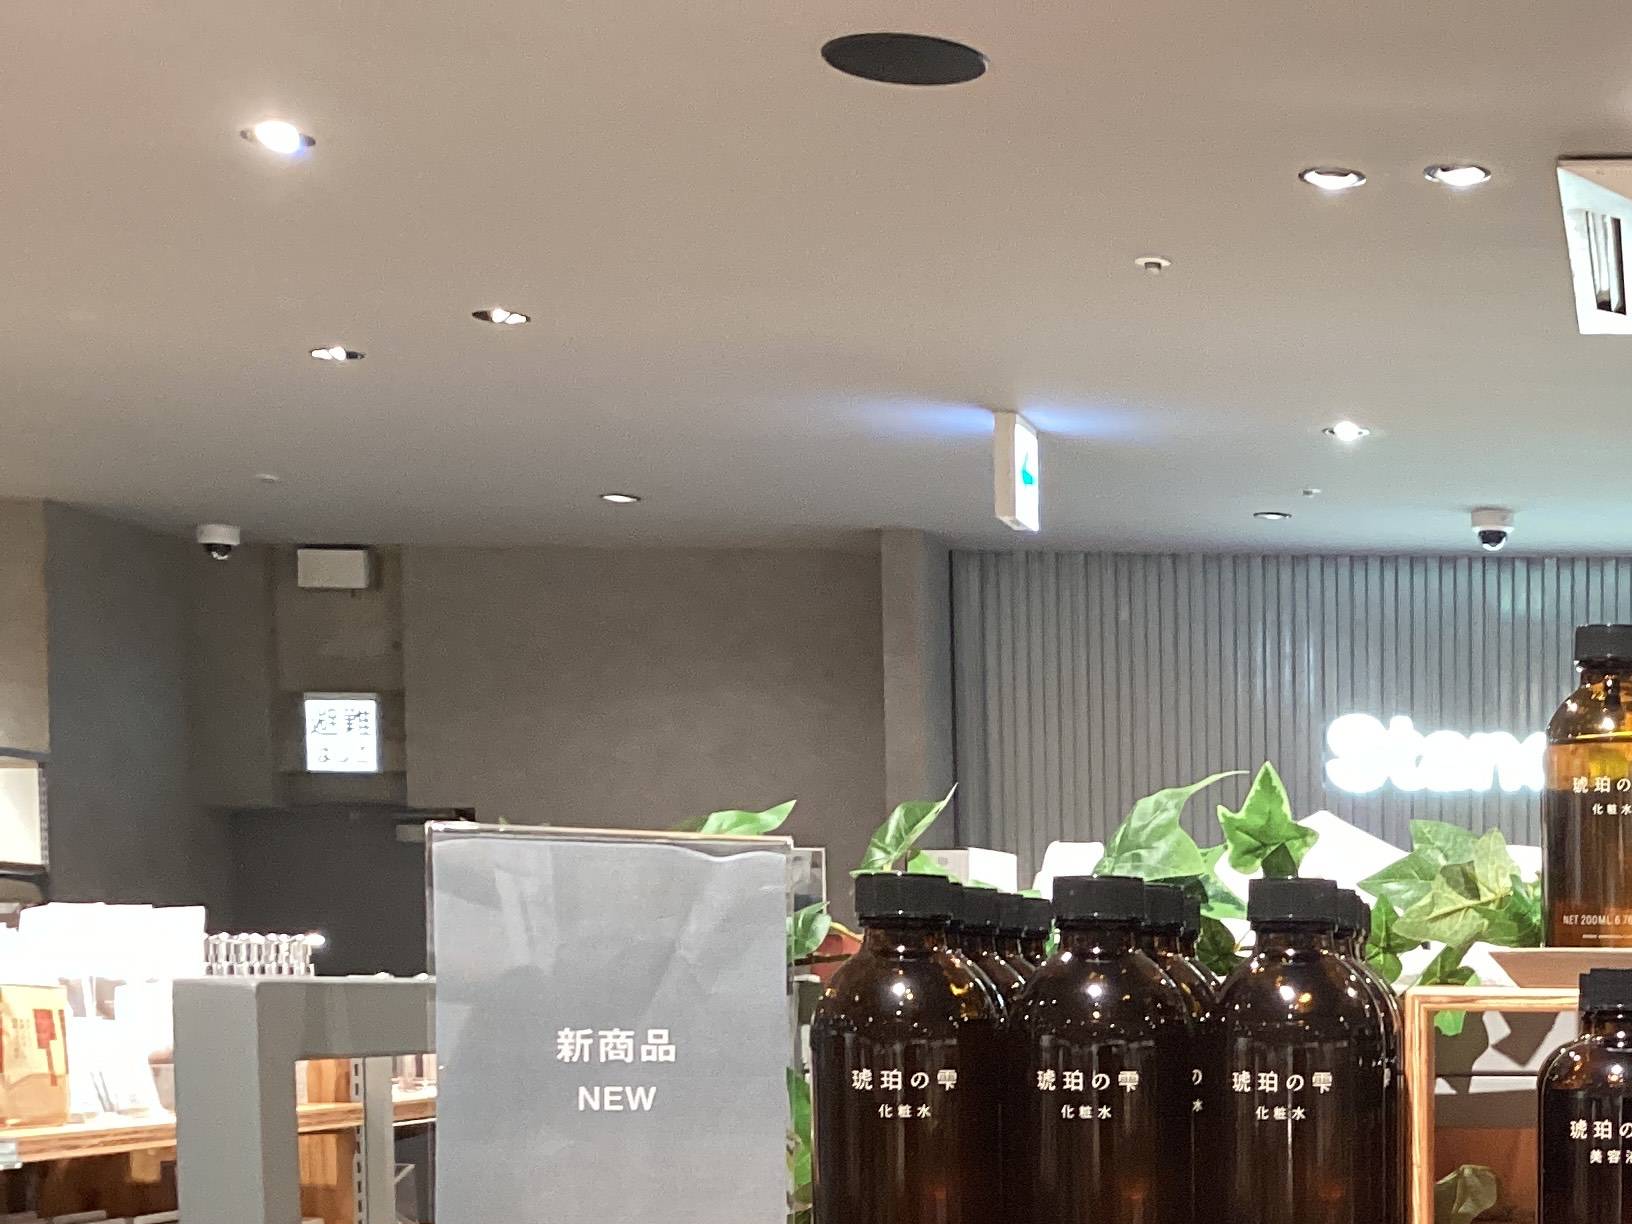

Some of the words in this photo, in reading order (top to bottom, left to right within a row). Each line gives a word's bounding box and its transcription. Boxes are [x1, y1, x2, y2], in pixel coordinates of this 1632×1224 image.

[1592, 803, 1632, 815] 化粧水
[556, 1027, 676, 1063] 新商品
[852, 1068, 957, 1091] 琥珀の雫
[1037, 1069, 1139, 1093] 琥珀の雫
[1232, 1070, 1332, 1094] 琥珀の雫
[579, 1086, 656, 1111] NEW
[879, 1104, 931, 1118] 化粧水
[1061, 1105, 1111, 1119] 化粧水
[1256, 1105, 1305, 1121] 化粧水
